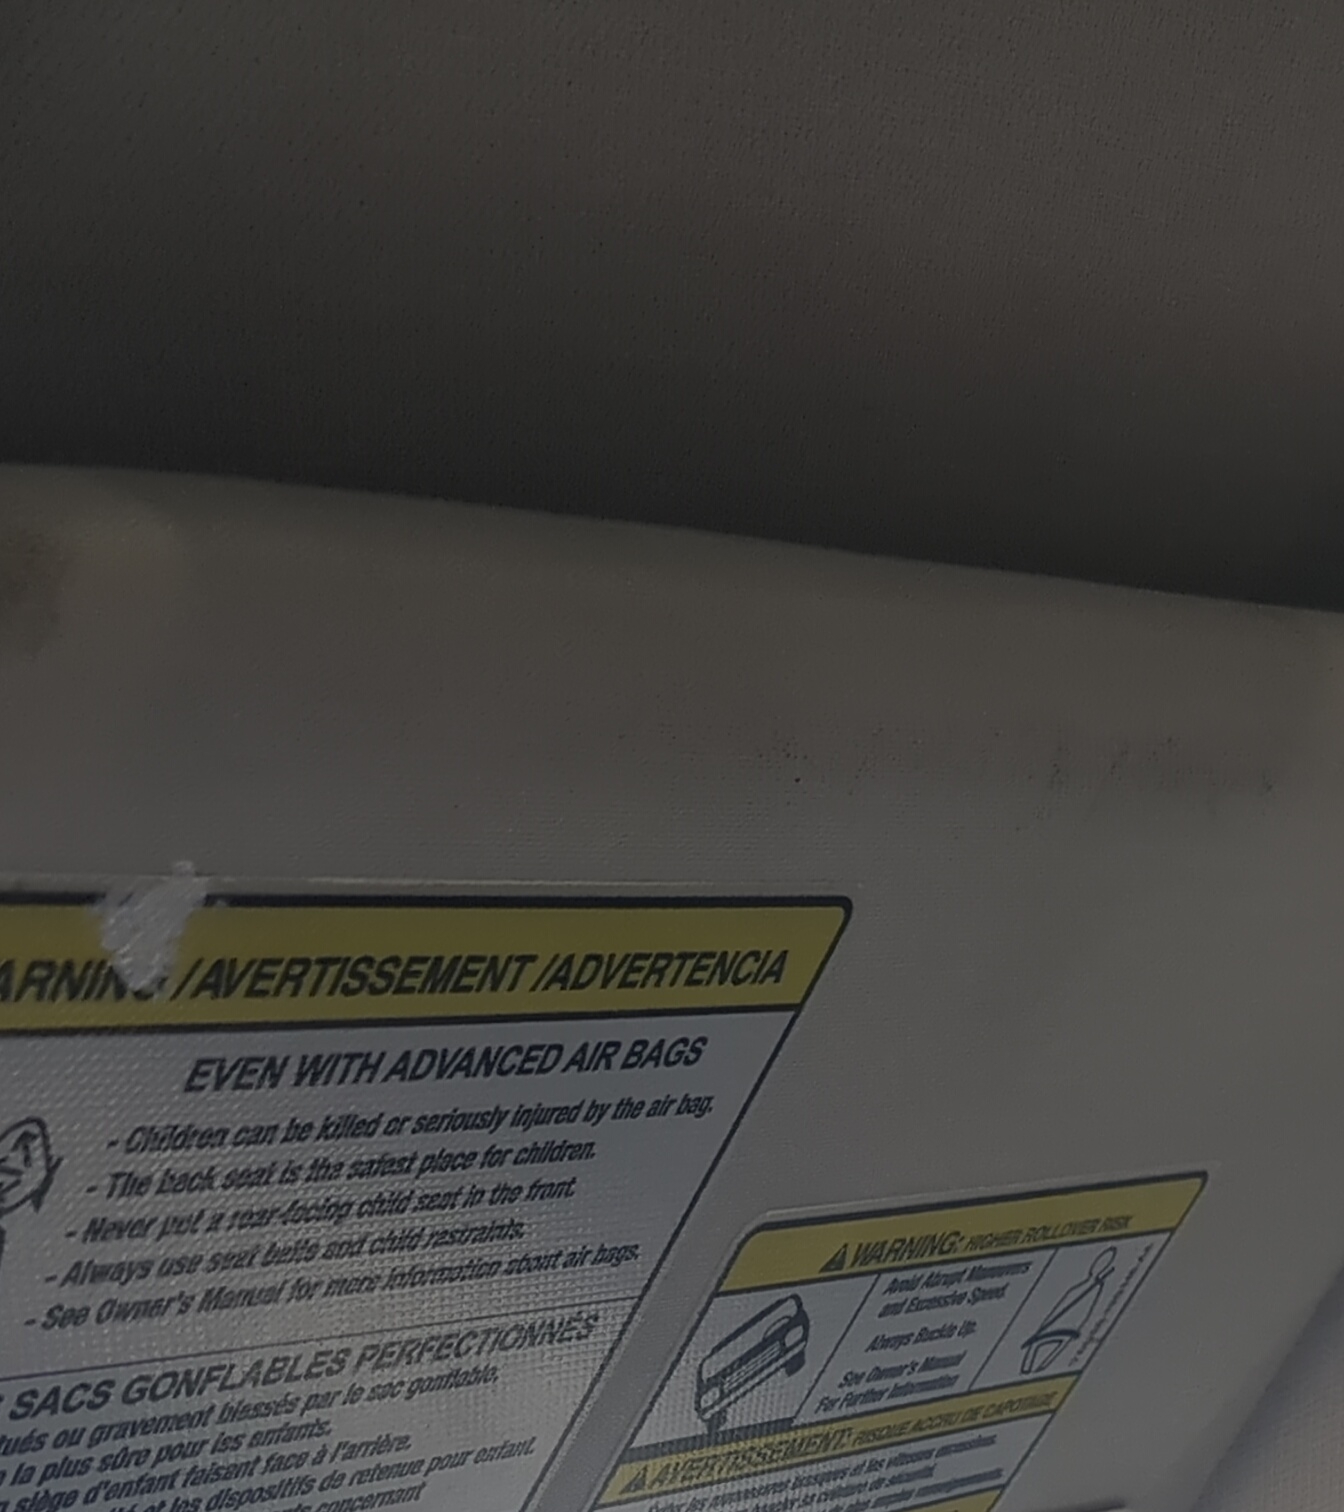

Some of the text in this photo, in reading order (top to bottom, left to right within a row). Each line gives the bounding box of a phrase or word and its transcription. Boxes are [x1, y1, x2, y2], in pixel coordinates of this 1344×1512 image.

[173, 954, 537, 999] /AVERTISSEMENT
[531, 949, 787, 991] /ADVERTENCIA
[183, 1035, 708, 1093] EVEN WITH ADVANCED AIR BAGS
[123, 1092, 714, 1154] Children can be killed or seriously injured by the air bag.
[849, 1230, 965, 1267] WARNING:
[1020, 1218, 1100, 1243] ROLLOVER
[8, 1378, 116, 1420] SACS
[121, 1347, 351, 1405] GONFLABLES
[204, 1474, 316, 1512] dispositifs
[317, 1468, 347, 1492] de
[347, 1458, 425, 1486] retenue
[422, 1449, 475, 1477] pour
[472, 1435, 537, 1464] enfant.
